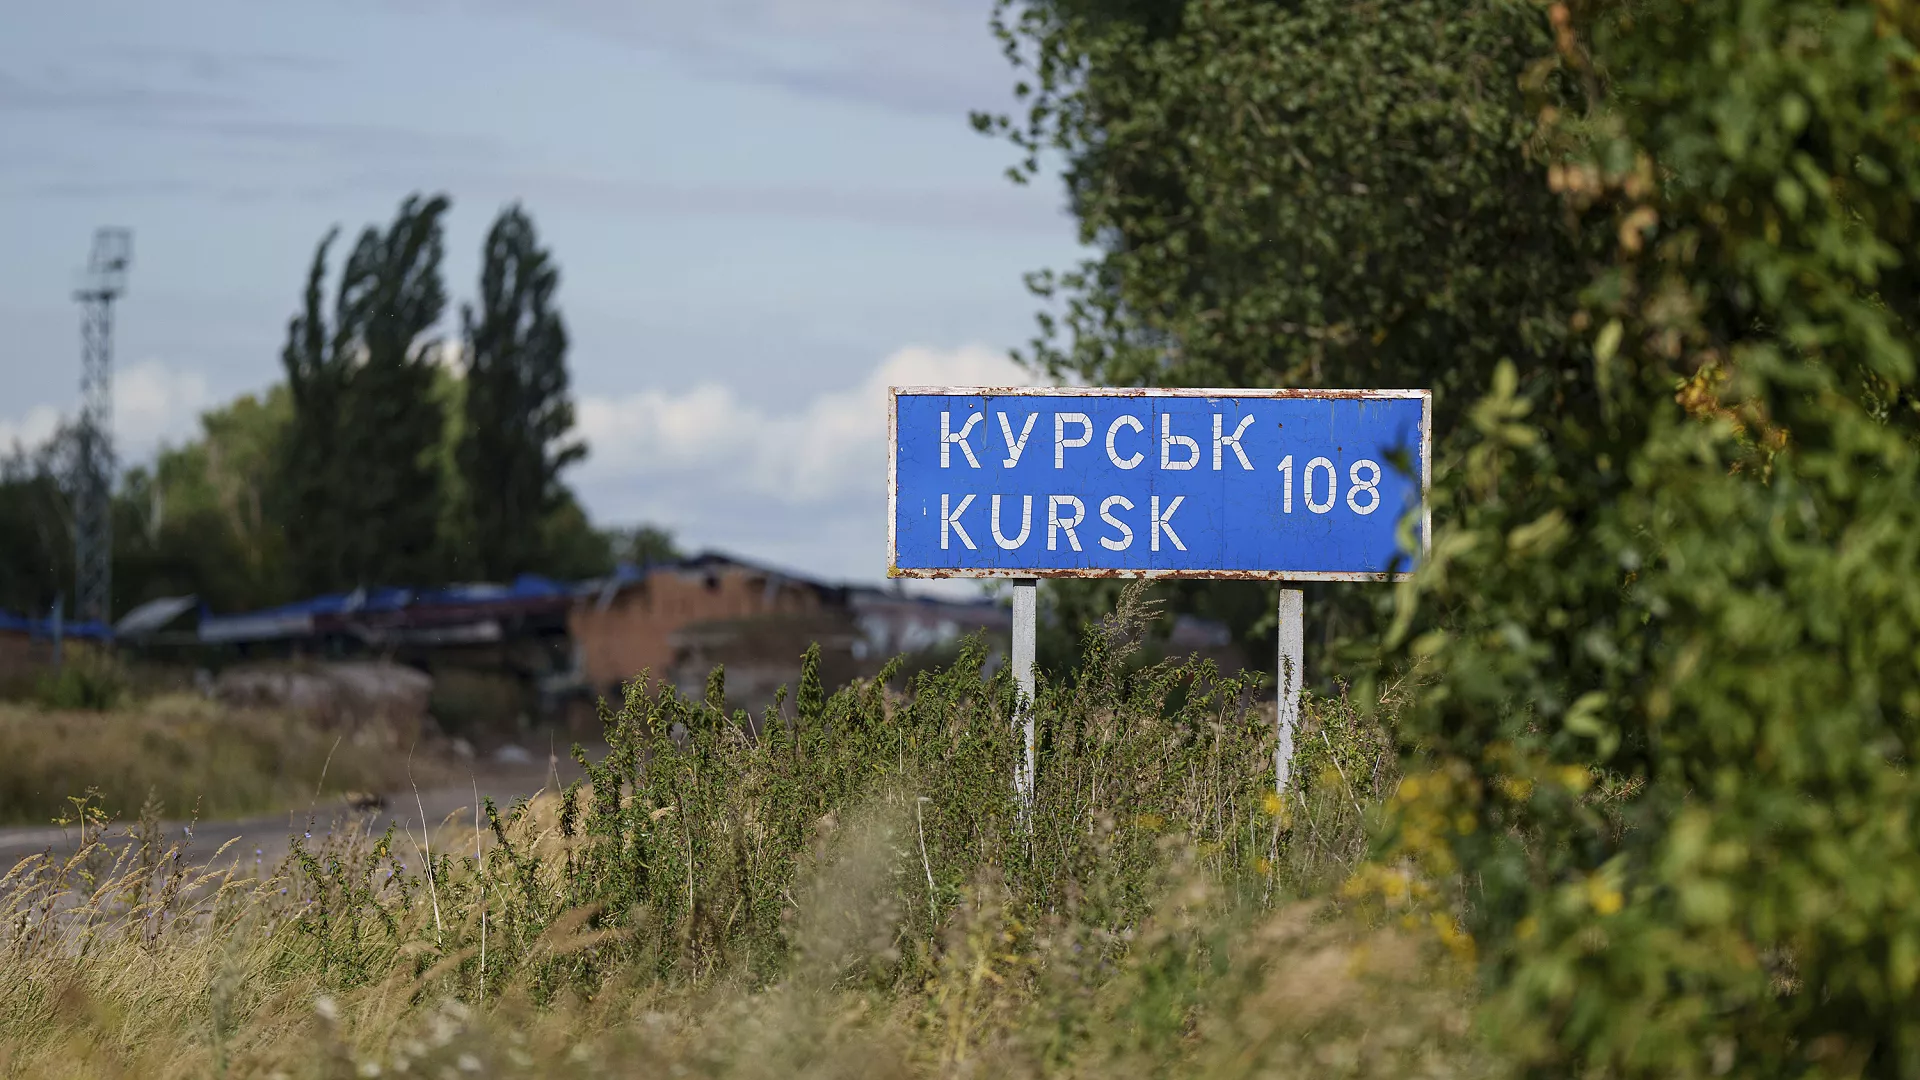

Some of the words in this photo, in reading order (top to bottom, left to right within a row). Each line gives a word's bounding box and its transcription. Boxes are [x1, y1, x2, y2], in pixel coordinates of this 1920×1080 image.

[940, 411, 1256, 471] КУРСЬК
[1277, 454, 1382, 516] 108
[940, 493, 1188, 552] KURSK
